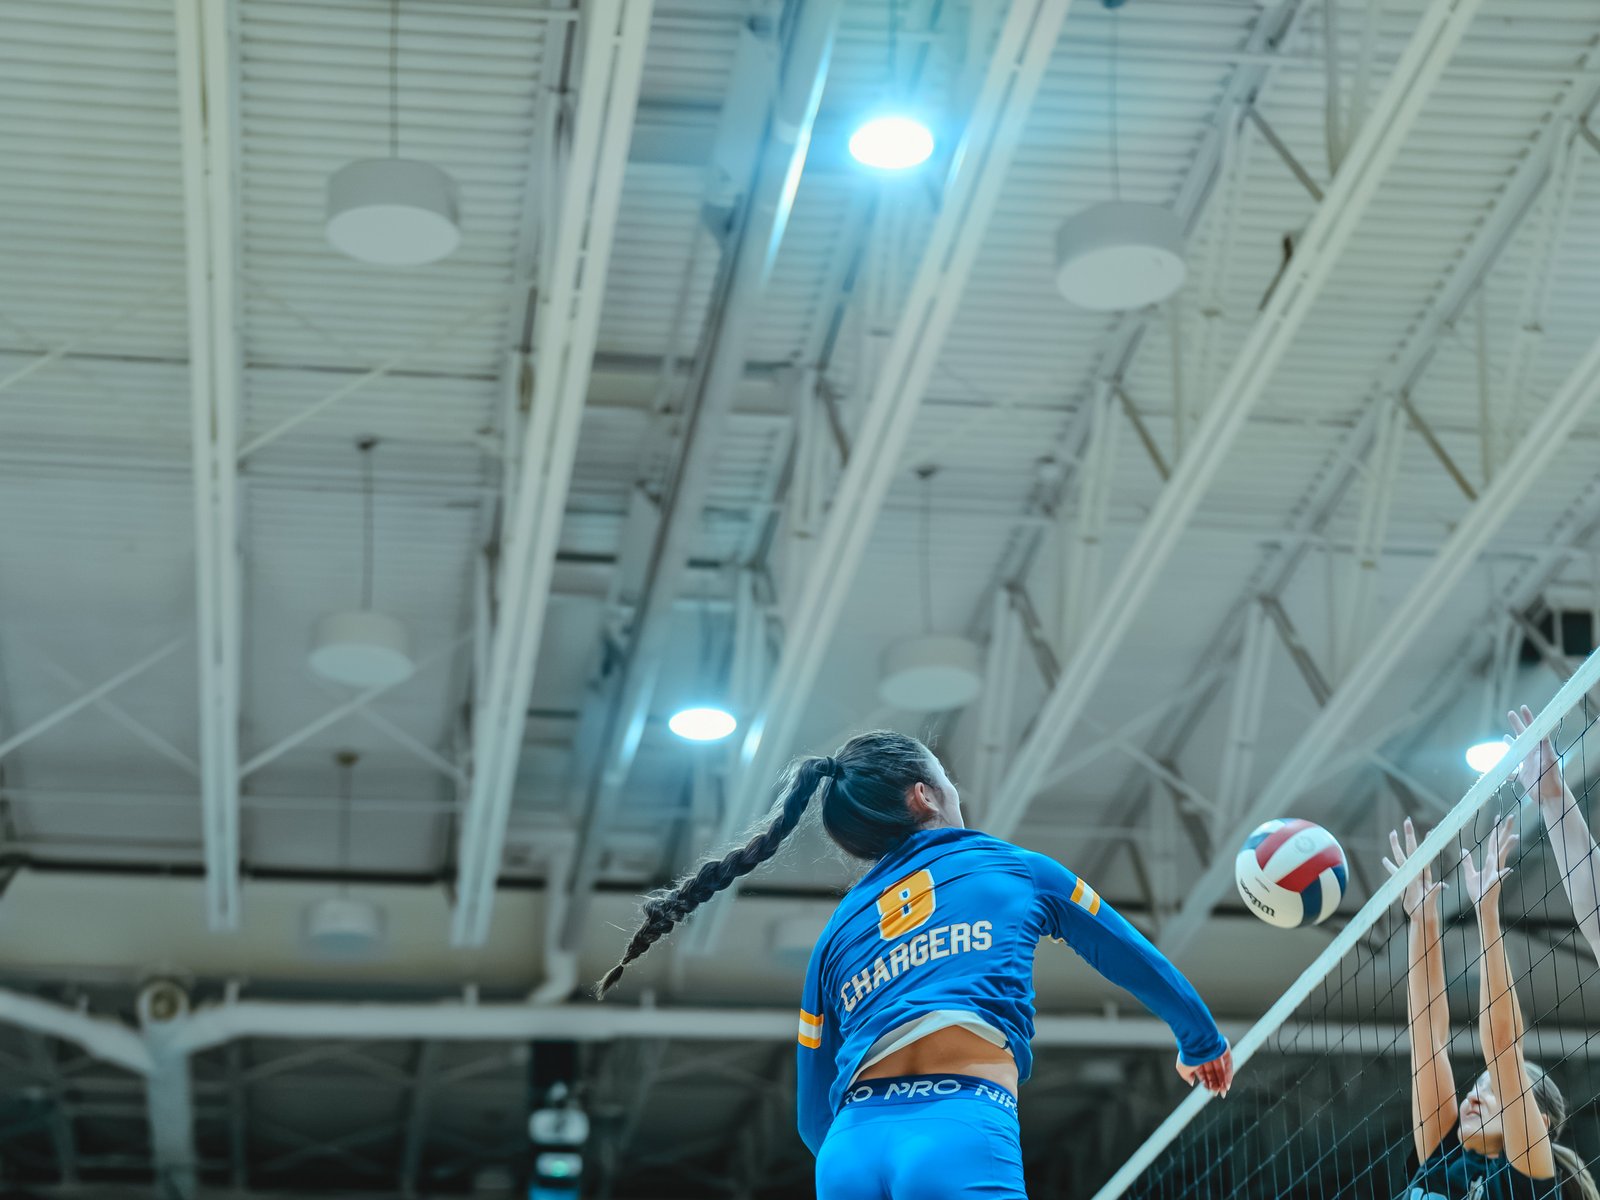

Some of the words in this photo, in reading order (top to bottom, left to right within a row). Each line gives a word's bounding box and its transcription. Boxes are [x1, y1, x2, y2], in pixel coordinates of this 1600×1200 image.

[876, 868, 936, 941] 8
[840, 920, 993, 1012] CHARGERS
[884, 1079, 962, 1100] PRO
